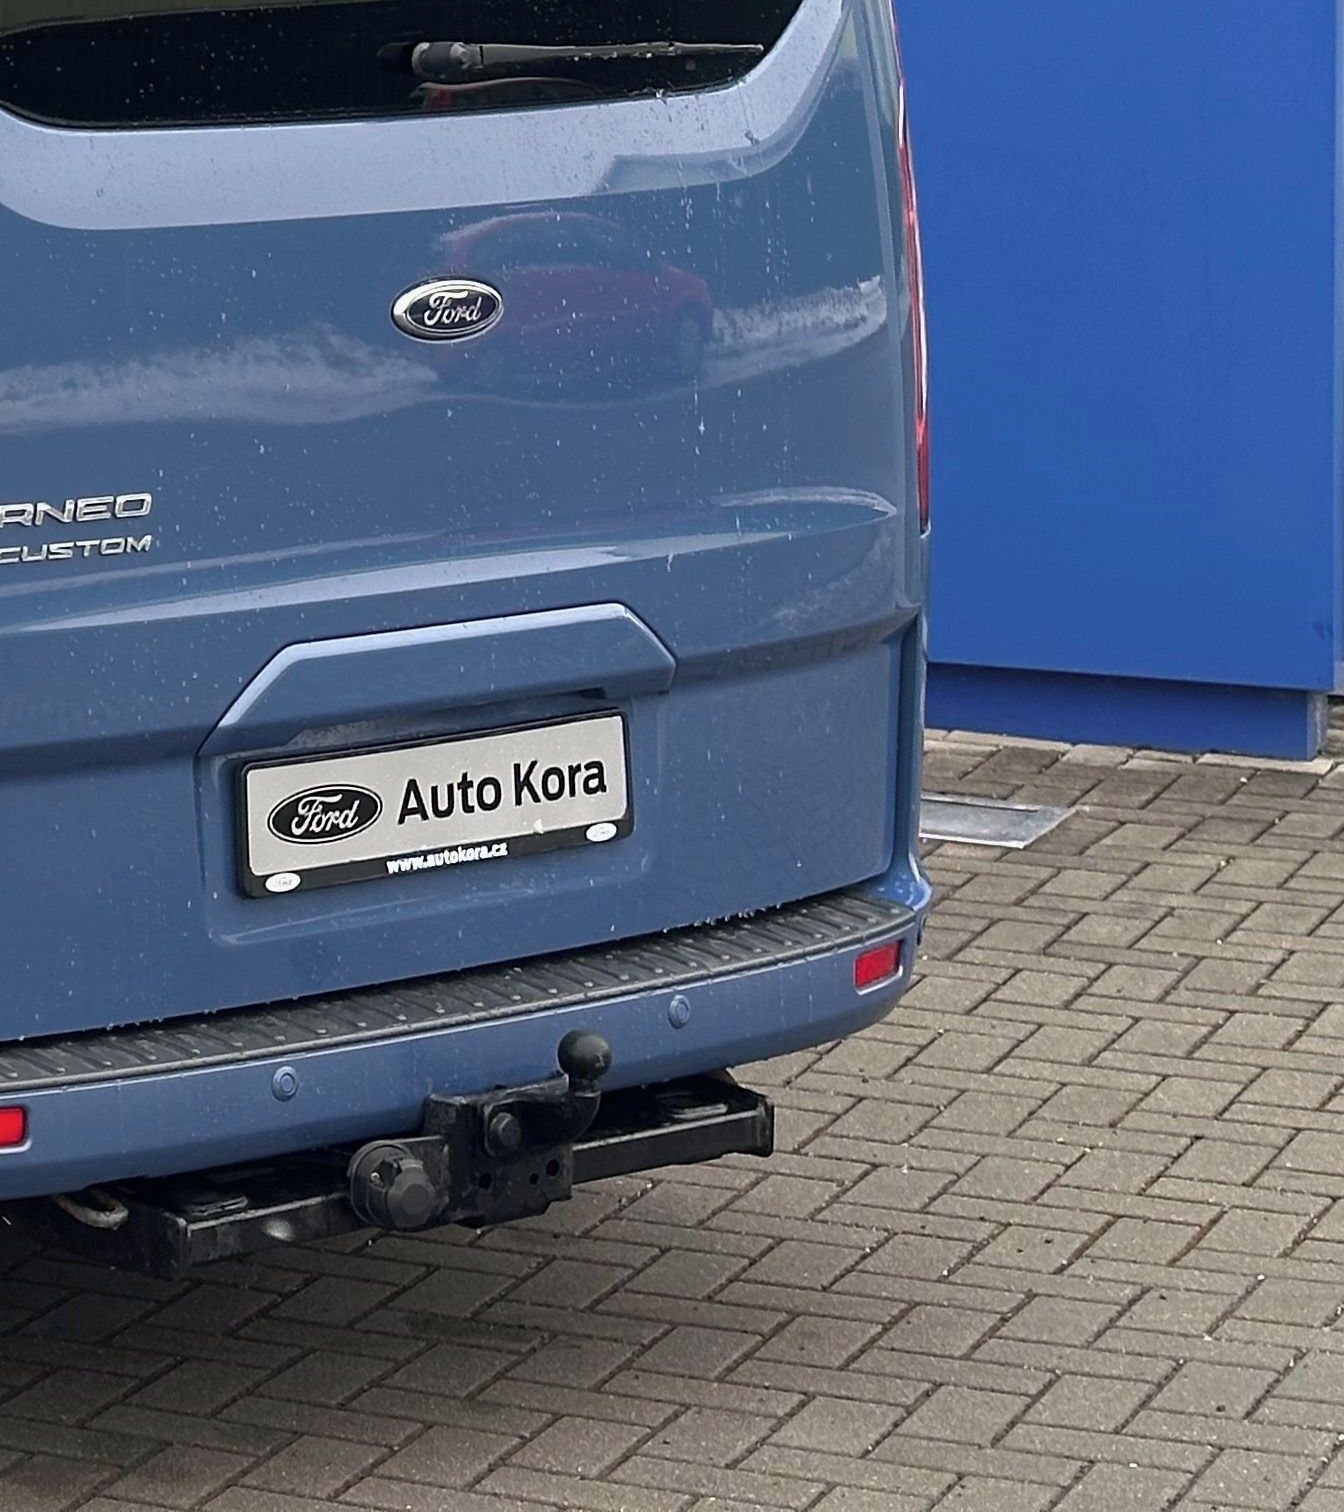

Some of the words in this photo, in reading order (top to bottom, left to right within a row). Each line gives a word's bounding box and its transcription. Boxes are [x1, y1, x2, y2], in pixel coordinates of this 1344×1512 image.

[423, 290, 483, 326] Ford
[289, 792, 361, 837] Ford
[396, 771, 503, 826] Auto
[512, 758, 608, 807] Kora
[385, 841, 510, 875] www.autokora.cz
